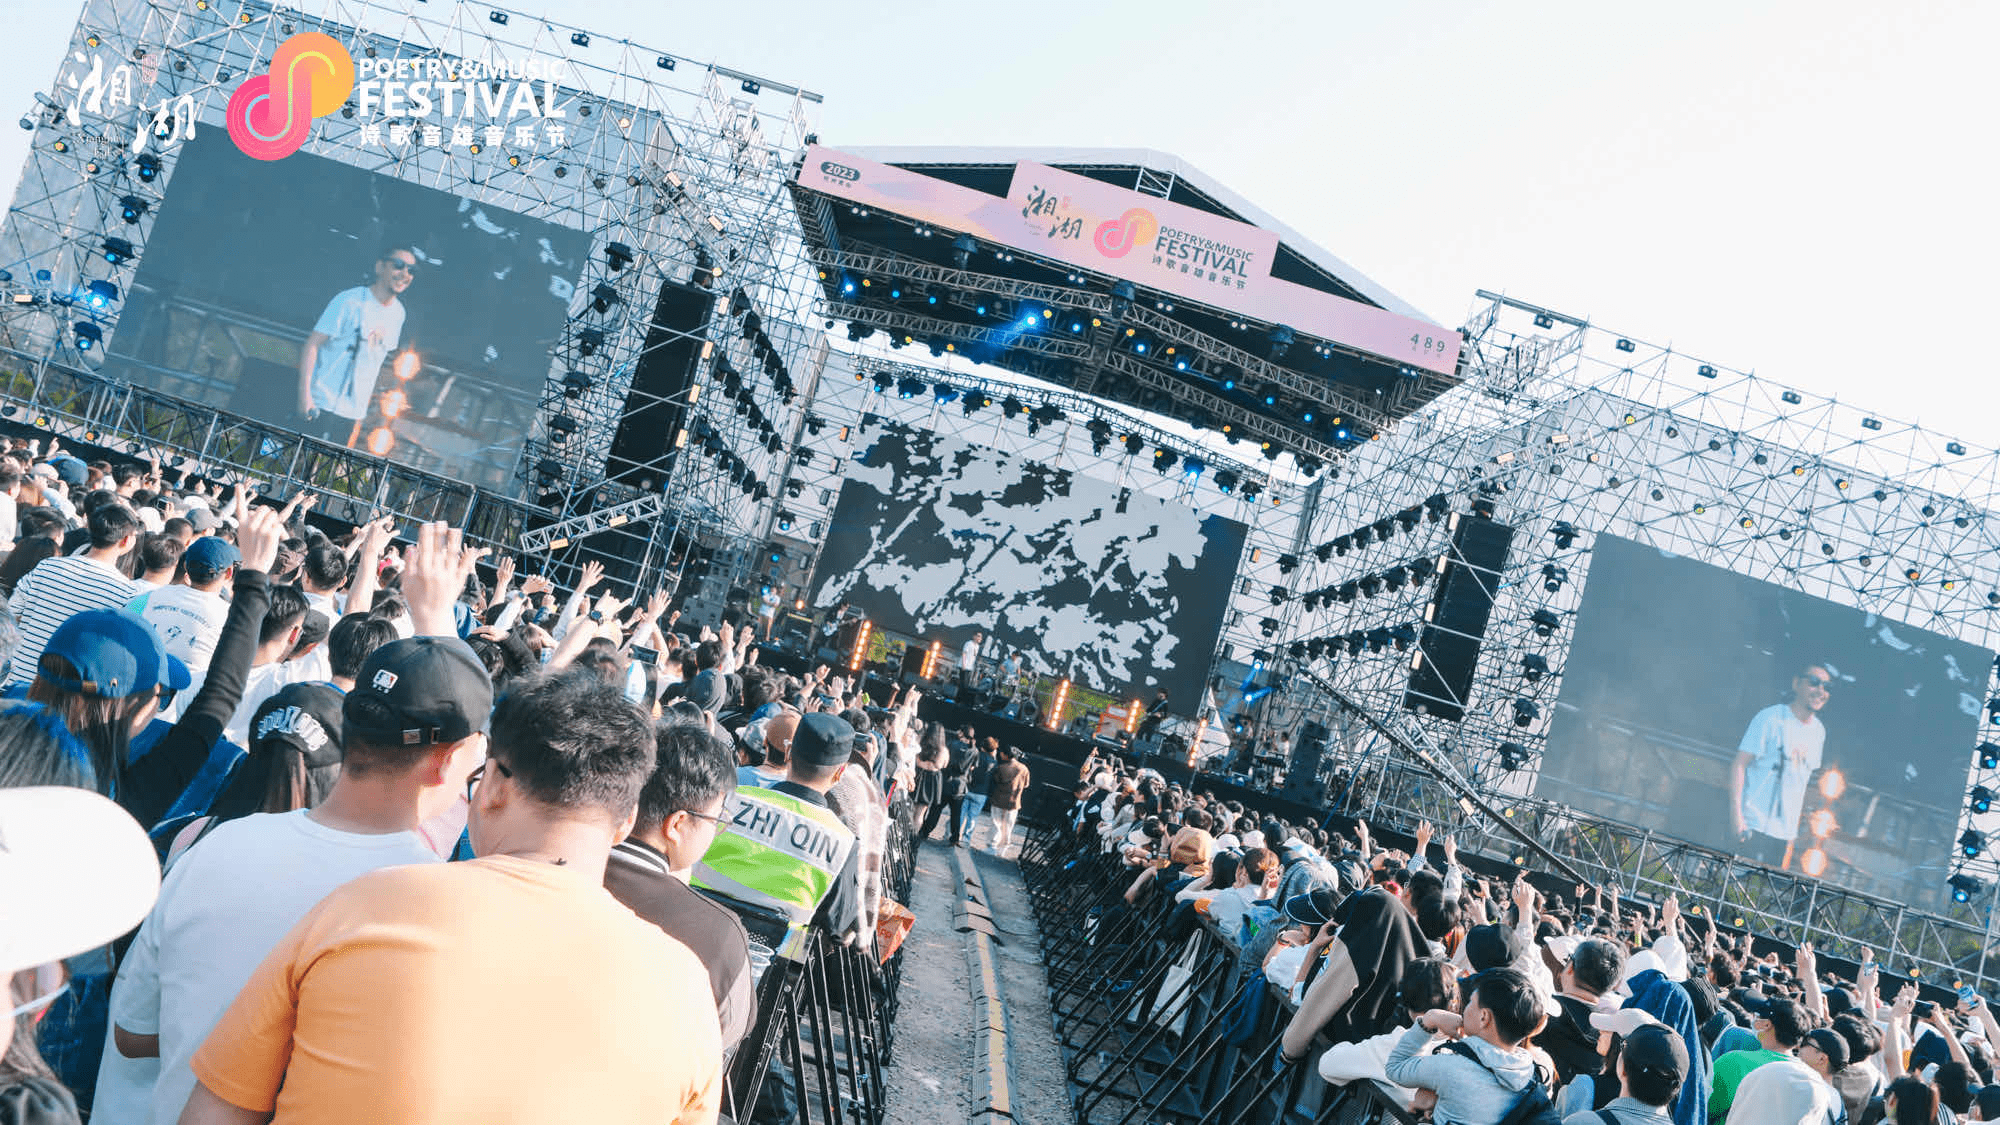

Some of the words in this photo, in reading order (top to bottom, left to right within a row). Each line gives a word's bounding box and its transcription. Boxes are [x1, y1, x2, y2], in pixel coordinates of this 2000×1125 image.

[825, 163, 856, 179] 2023
[1155, 235, 1248, 279] FESTIVAL
[1160, 225, 1255, 262] POETRY&MUSIC
[732, 801, 781, 838] ZHI
[790, 823, 840, 863] QIN
